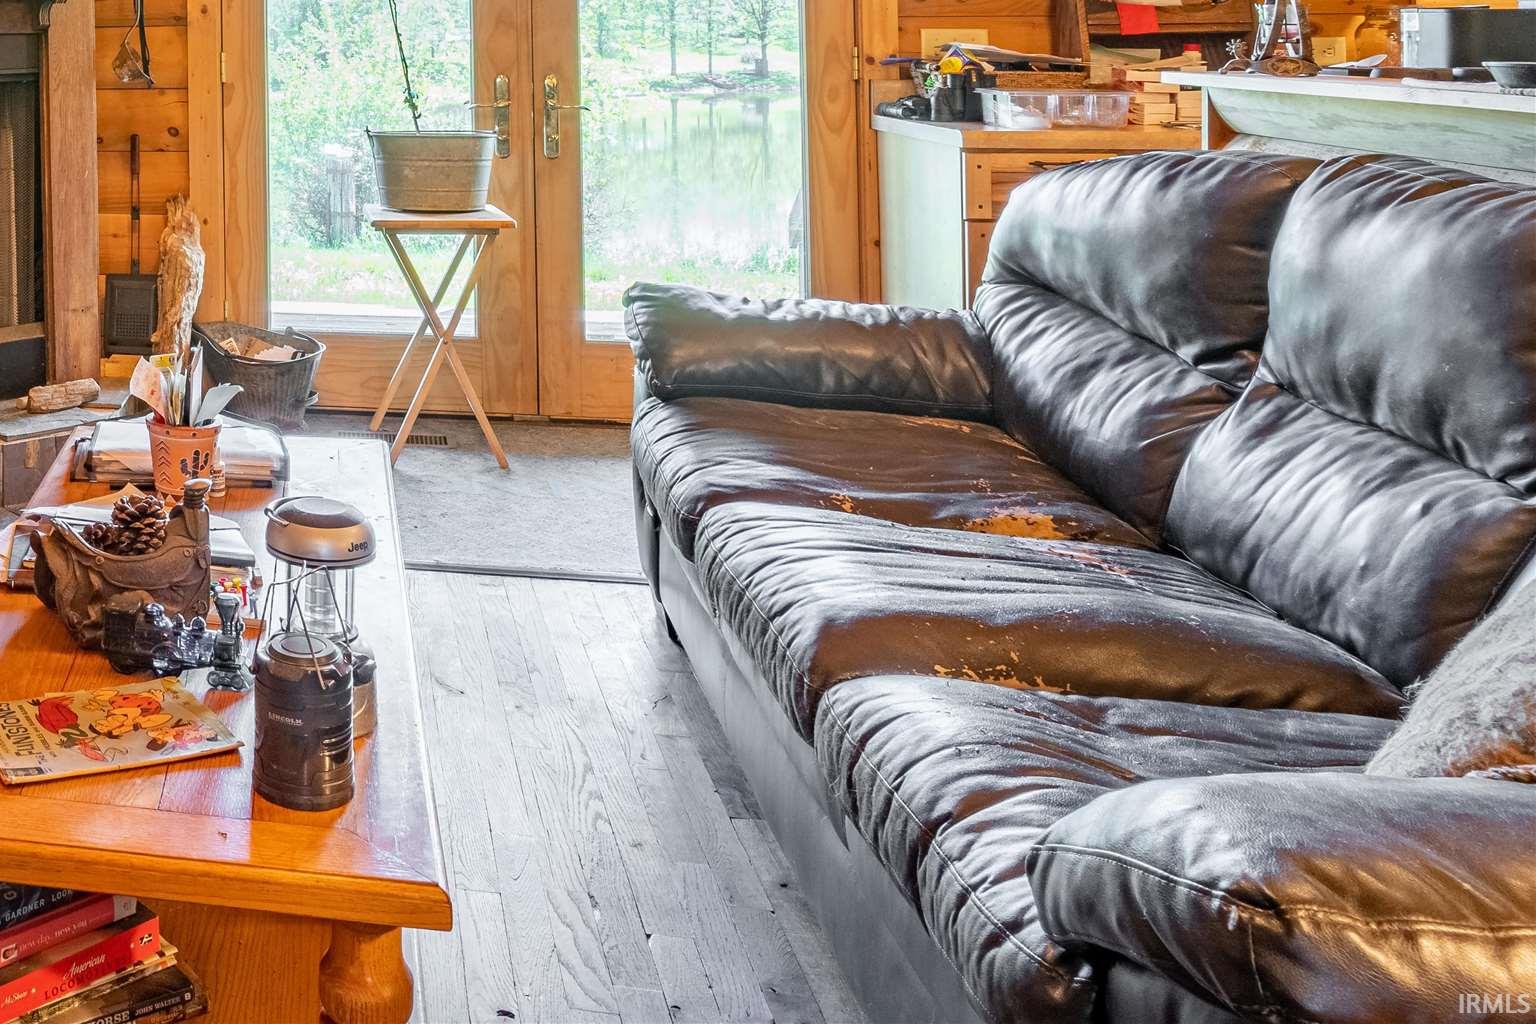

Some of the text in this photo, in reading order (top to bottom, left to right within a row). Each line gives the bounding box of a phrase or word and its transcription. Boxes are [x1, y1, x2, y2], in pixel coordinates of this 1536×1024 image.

[348, 541, 368, 553] Jeep
[5, 898, 46, 922] GARDNER
[64, 953, 106, 979] American
[135, 1004, 154, 1017] JOHN
[154, 996, 182, 1010] WALTER
